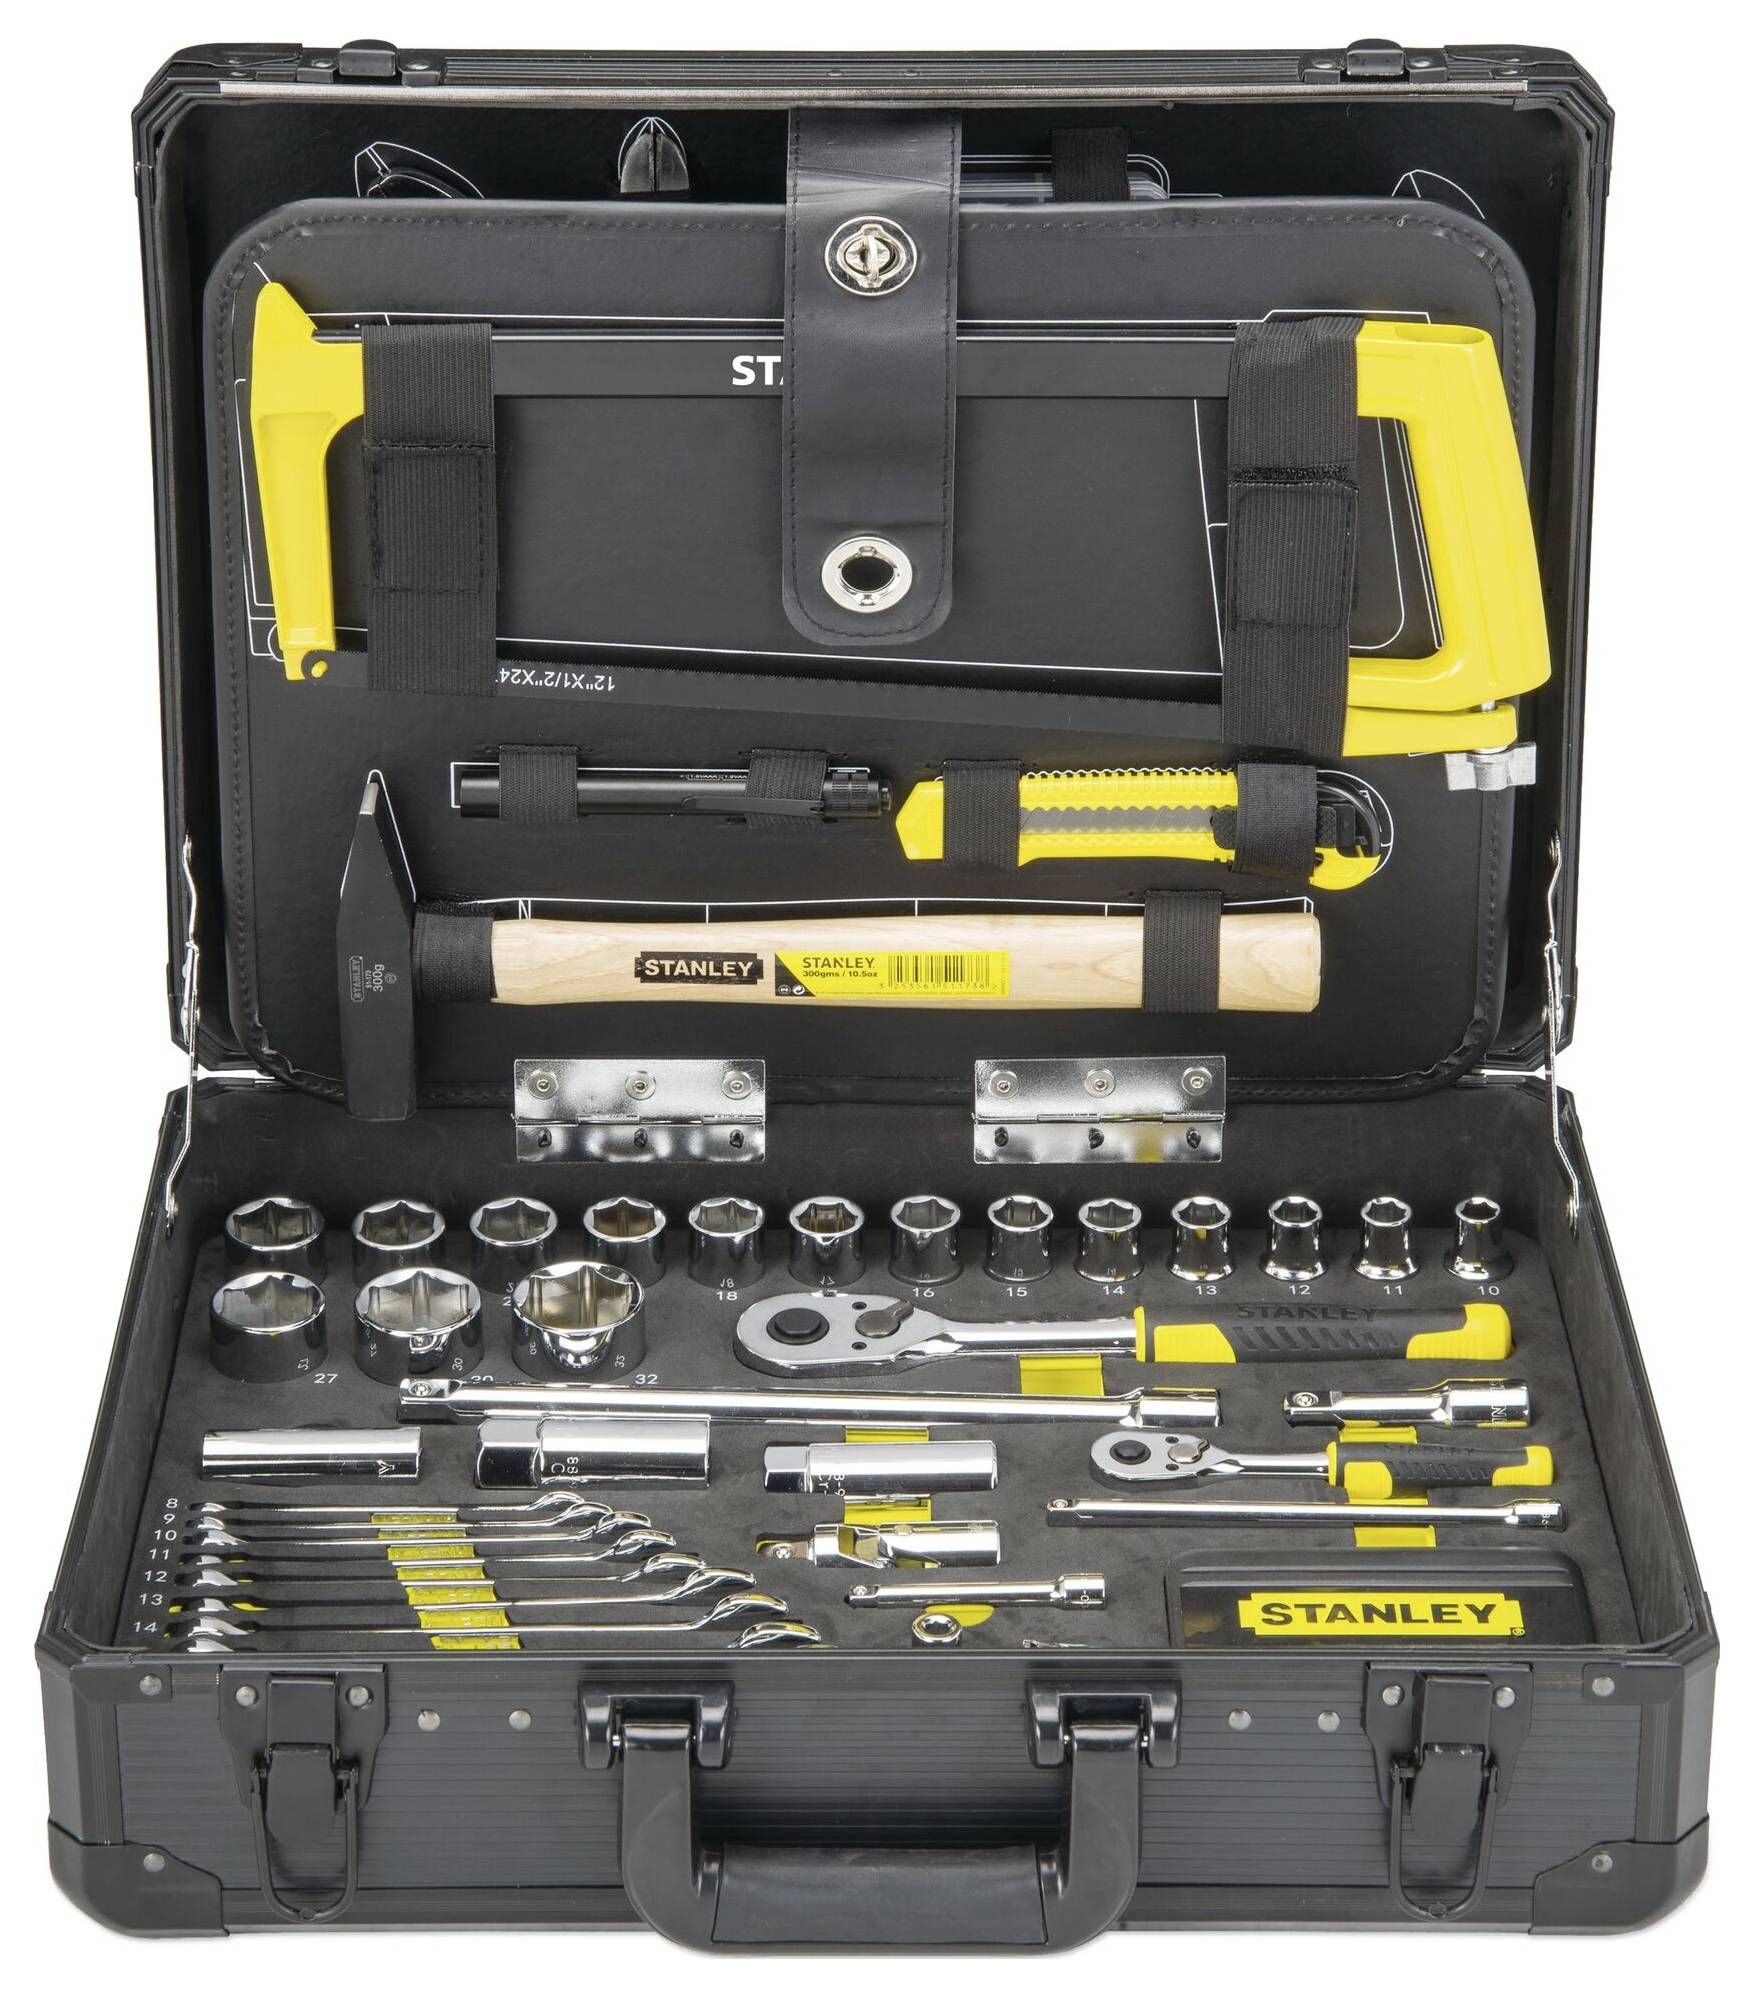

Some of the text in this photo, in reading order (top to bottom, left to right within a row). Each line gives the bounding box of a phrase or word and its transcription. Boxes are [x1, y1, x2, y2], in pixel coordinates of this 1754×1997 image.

[731, 354, 784, 386] ST
[644, 959, 753, 977] STANLEY
[803, 957, 875, 968] STANLEY
[373, 965, 385, 992] 300g
[803, 970, 840, 978] 300gms
[716, 1291, 738, 1300] 18
[912, 1288, 935, 1297] 16
[1006, 1287, 1028, 1297] 15
[1103, 1286, 1125, 1295] 14
[1195, 1286, 1217, 1295] 13
[1289, 1285, 1311, 1295] 12
[1383, 1285, 1403, 1295] 11
[1478, 1285, 1500, 1295] 10
[1238, 1304, 1377, 1322] STANLEY
[313, 1373, 338, 1384] 27
[635, 1374, 658, 1385] 32
[166, 1498, 178, 1509] 8
[163, 1513, 175, 1524] 9
[154, 1529, 177, 1541] 10
[150, 1549, 169, 1560] 11
[145, 1570, 168, 1583] 12
[139, 1593, 163, 1606] 13
[1260, 1602, 1497, 1625] STANLEY
[133, 1621, 157, 1633] 14
